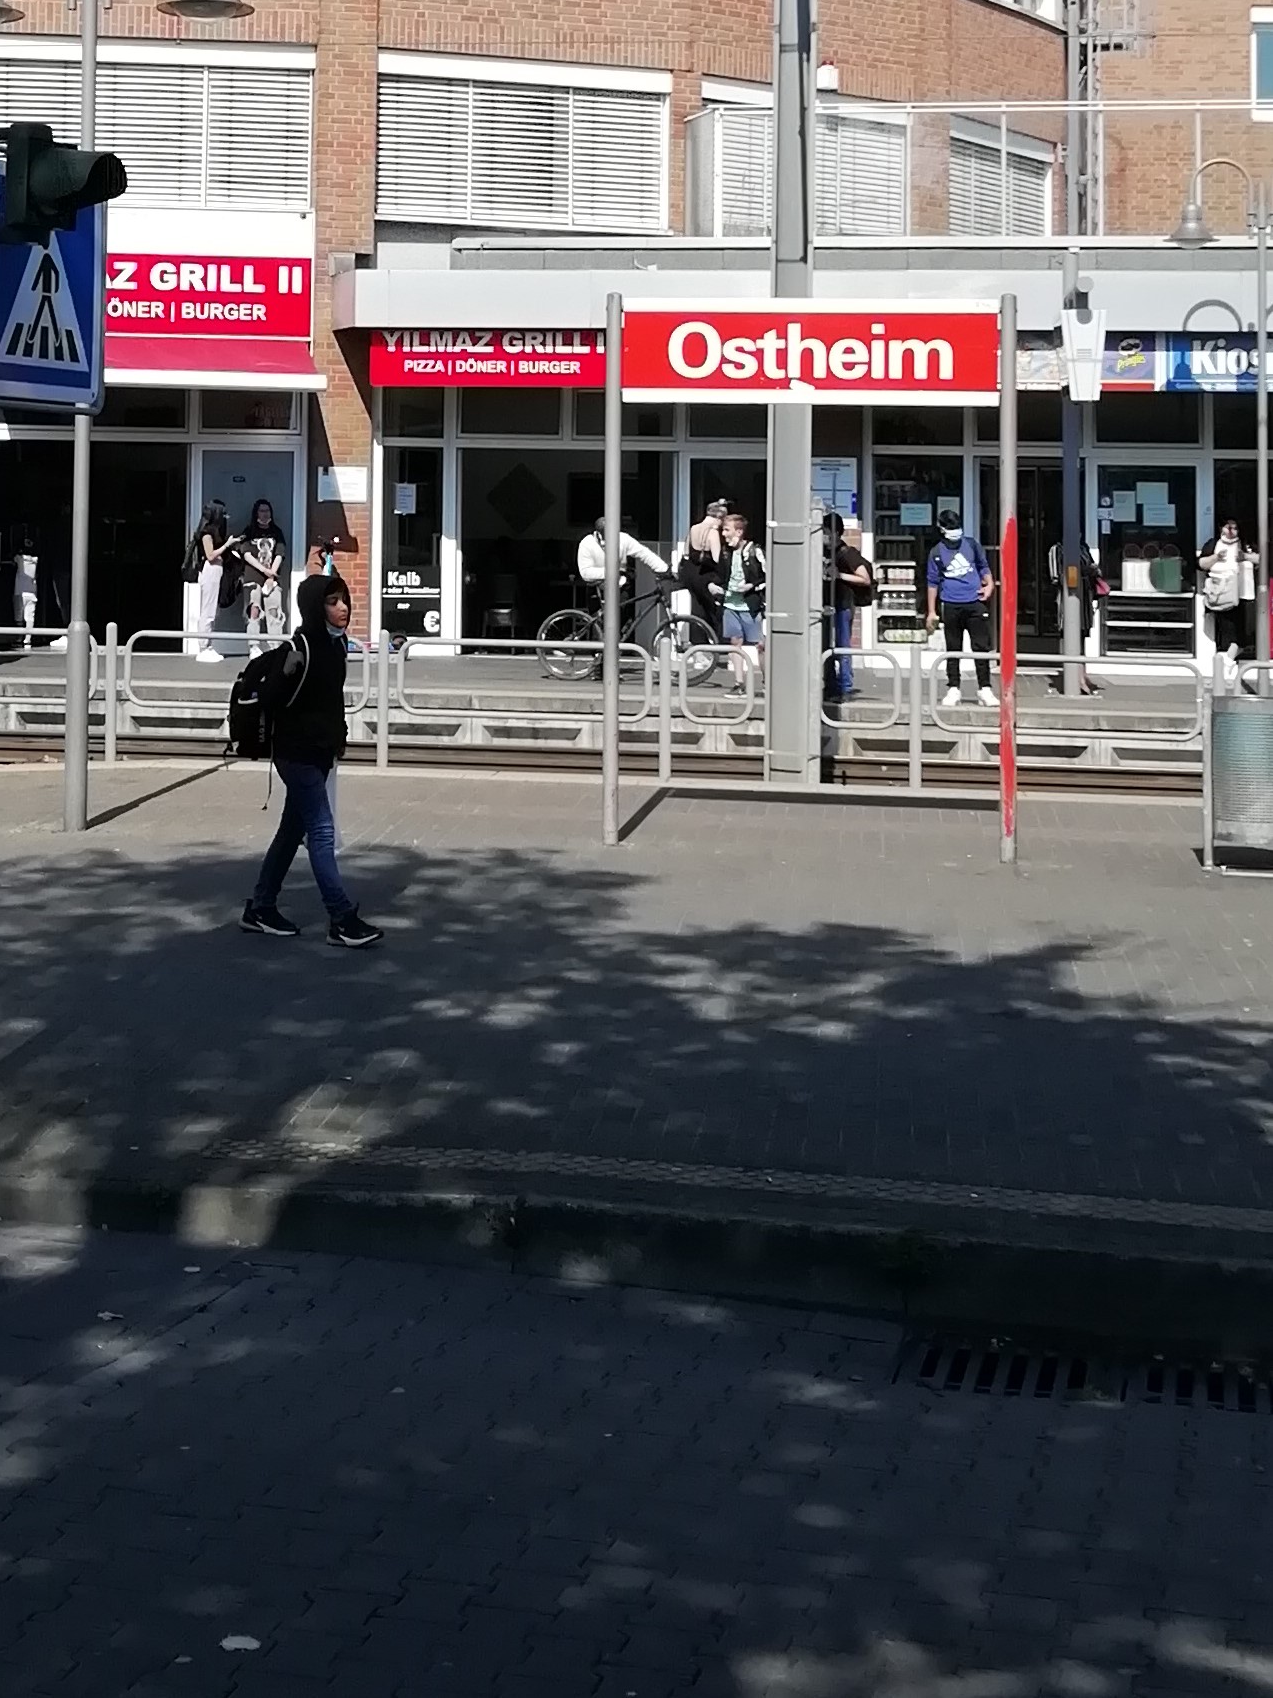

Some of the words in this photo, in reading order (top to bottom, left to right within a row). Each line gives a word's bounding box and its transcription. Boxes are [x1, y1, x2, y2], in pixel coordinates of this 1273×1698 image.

[150, 262, 266, 293] GRILL
[278, 265, 303, 294] II
[106, 297, 164, 318] ÖNER
[181, 303, 267, 320] BURGER
[383, 331, 494, 353] YILMAZ
[502, 331, 590, 354] GRILL
[667, 320, 954, 380] Ostheim
[404, 359, 445, 373] PIZZA
[455, 358, 507, 373] DÖNER
[518, 361, 581, 374] BURGER
[1192, 338, 1273, 376] Kios
[387, 570, 421, 586] Kalb
